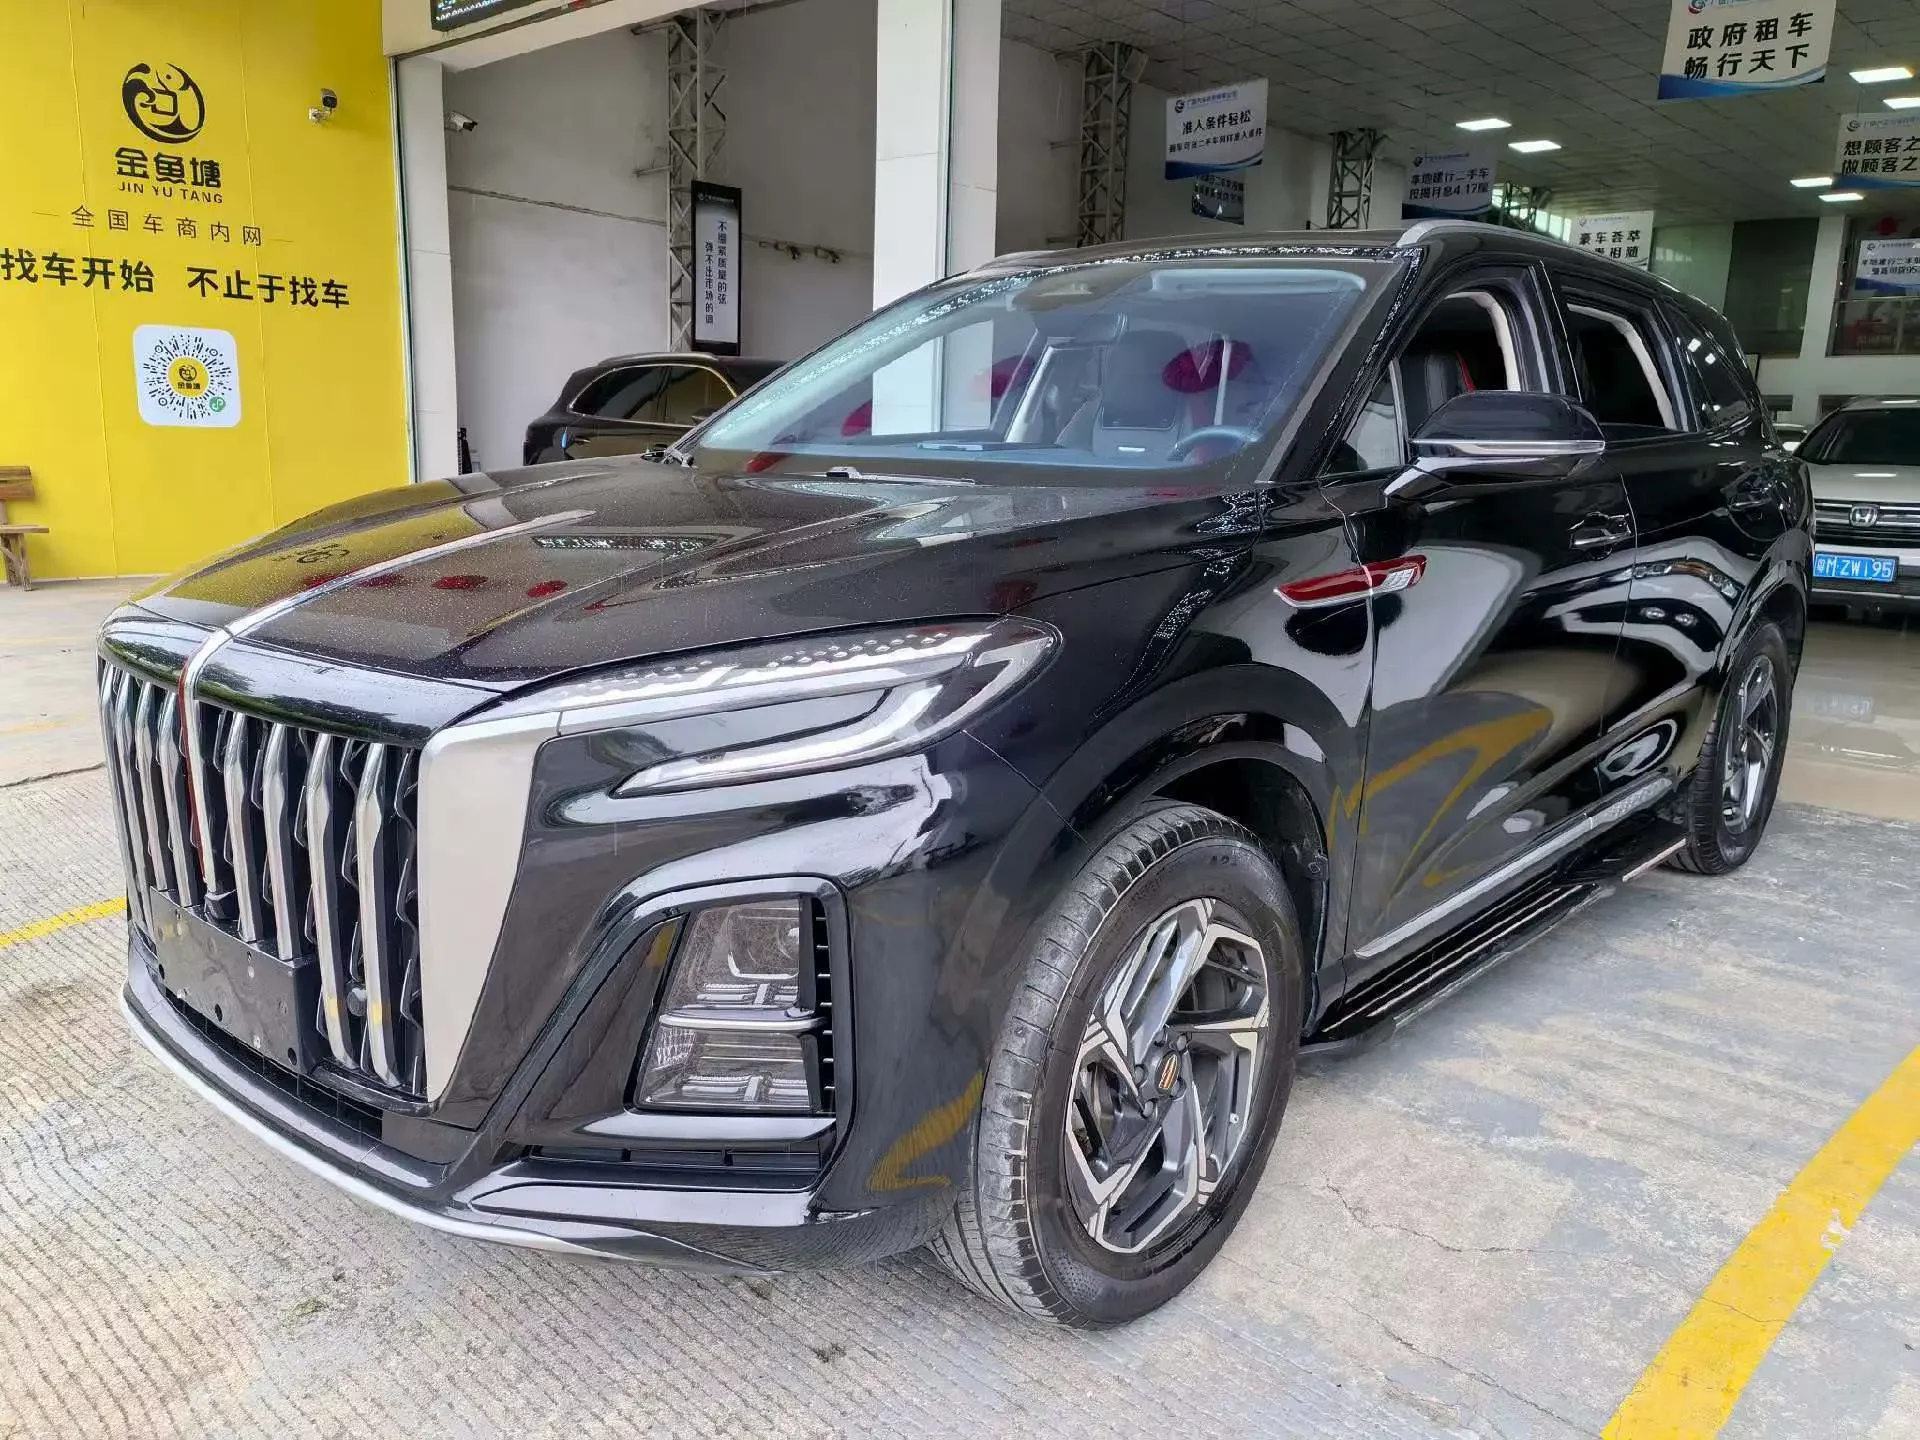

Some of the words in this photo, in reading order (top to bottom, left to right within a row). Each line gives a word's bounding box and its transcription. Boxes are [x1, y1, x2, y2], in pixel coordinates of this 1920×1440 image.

[1686, 12, 1814, 50] 政府租车
[1683, 43, 1810, 80] 畅行天下
[1843, 135, 1920, 156] 想顾客之
[115, 147, 222, 189] 金鱼塘
[1841, 156, 1918, 177] 做顾客之
[119, 182, 144, 194] JIN
[153, 186, 173, 198] YU
[180, 188, 223, 204] TANG
[71, 204, 262, 247] 全国车商内网
[0, 247, 154, 294] 找车开始
[186, 265, 350, 309] 不止于找车
